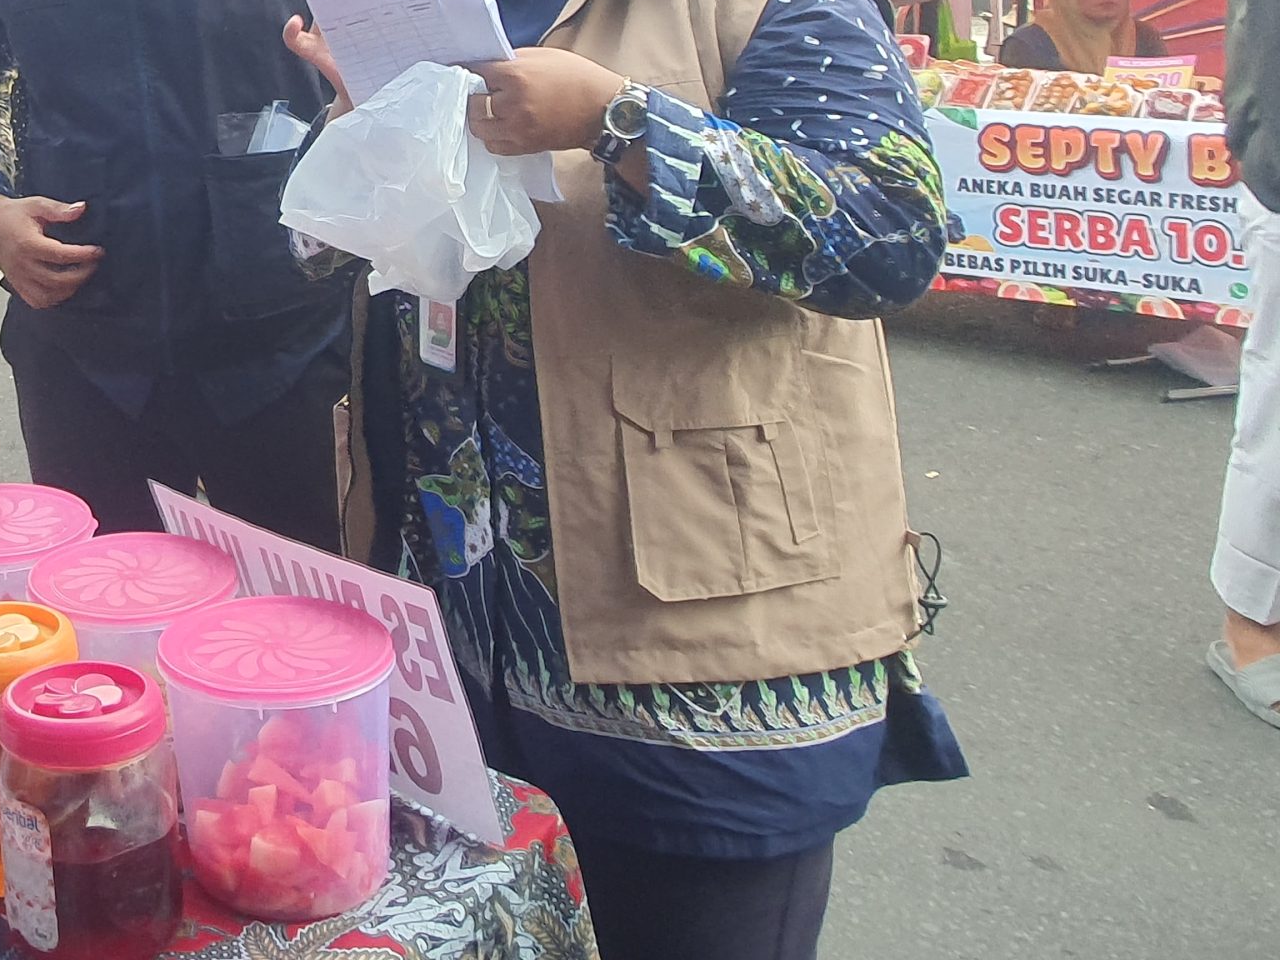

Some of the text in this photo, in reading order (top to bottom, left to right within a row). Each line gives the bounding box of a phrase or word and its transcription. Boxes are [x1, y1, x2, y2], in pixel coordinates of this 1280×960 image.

[978, 123, 1170, 183] SEPTY
[957, 178, 1239, 214] ANEKA BUAH SEGAR FRESH
[995, 205, 1157, 259] SERBA
[944, 252, 1203, 295] BEBAS PILIH SUKA-SUKA
